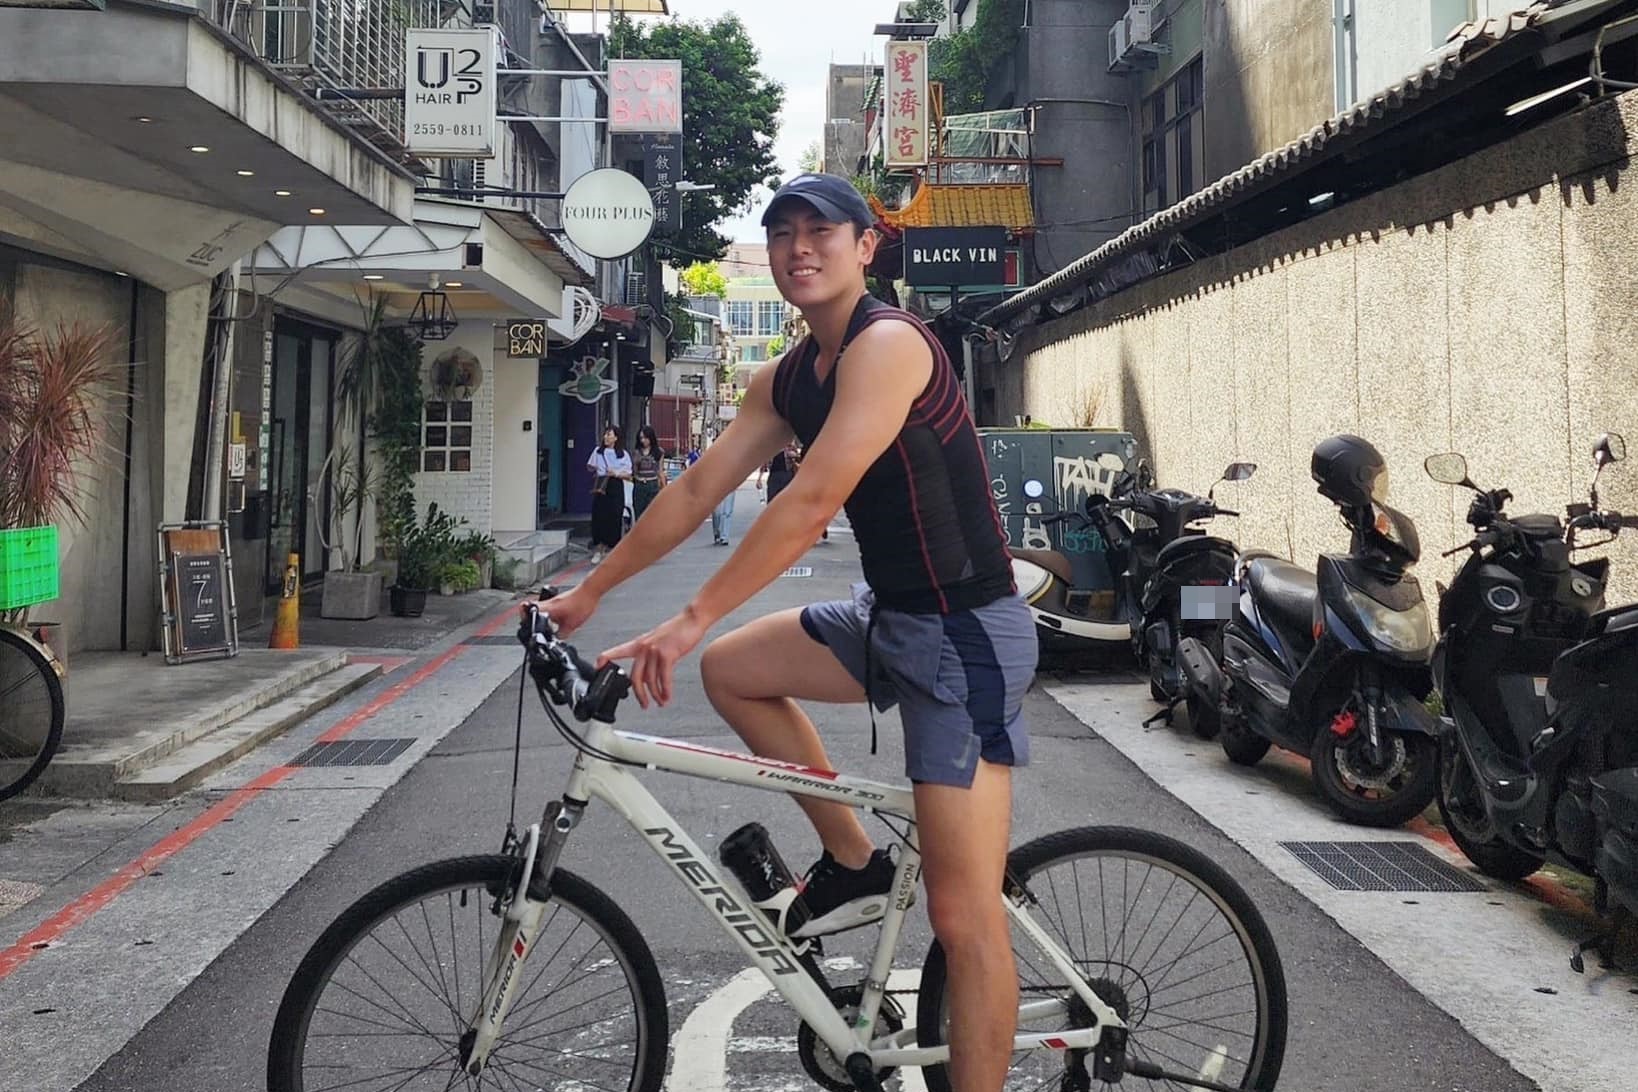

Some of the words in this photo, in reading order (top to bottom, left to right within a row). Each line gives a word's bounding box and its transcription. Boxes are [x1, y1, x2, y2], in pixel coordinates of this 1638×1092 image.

[613, 68, 677, 92] COR
[416, 93, 452, 104] HAIR
[893, 50, 921, 157] 聖濟宮
[614, 97, 677, 124] BAN
[414, 123, 483, 136] 2559-0811
[565, 206, 607, 219] FOUR
[613, 206, 652, 219] PLUS
[913, 248, 961, 263] BLACK
[968, 248, 997, 262] VIN
[510, 324, 544, 339] COR
[511, 339, 542, 355] BAN
[768, 772, 852, 794] WARRIOR
[895, 863, 916, 911] PASSION
[644, 827, 798, 976] MERIDA
